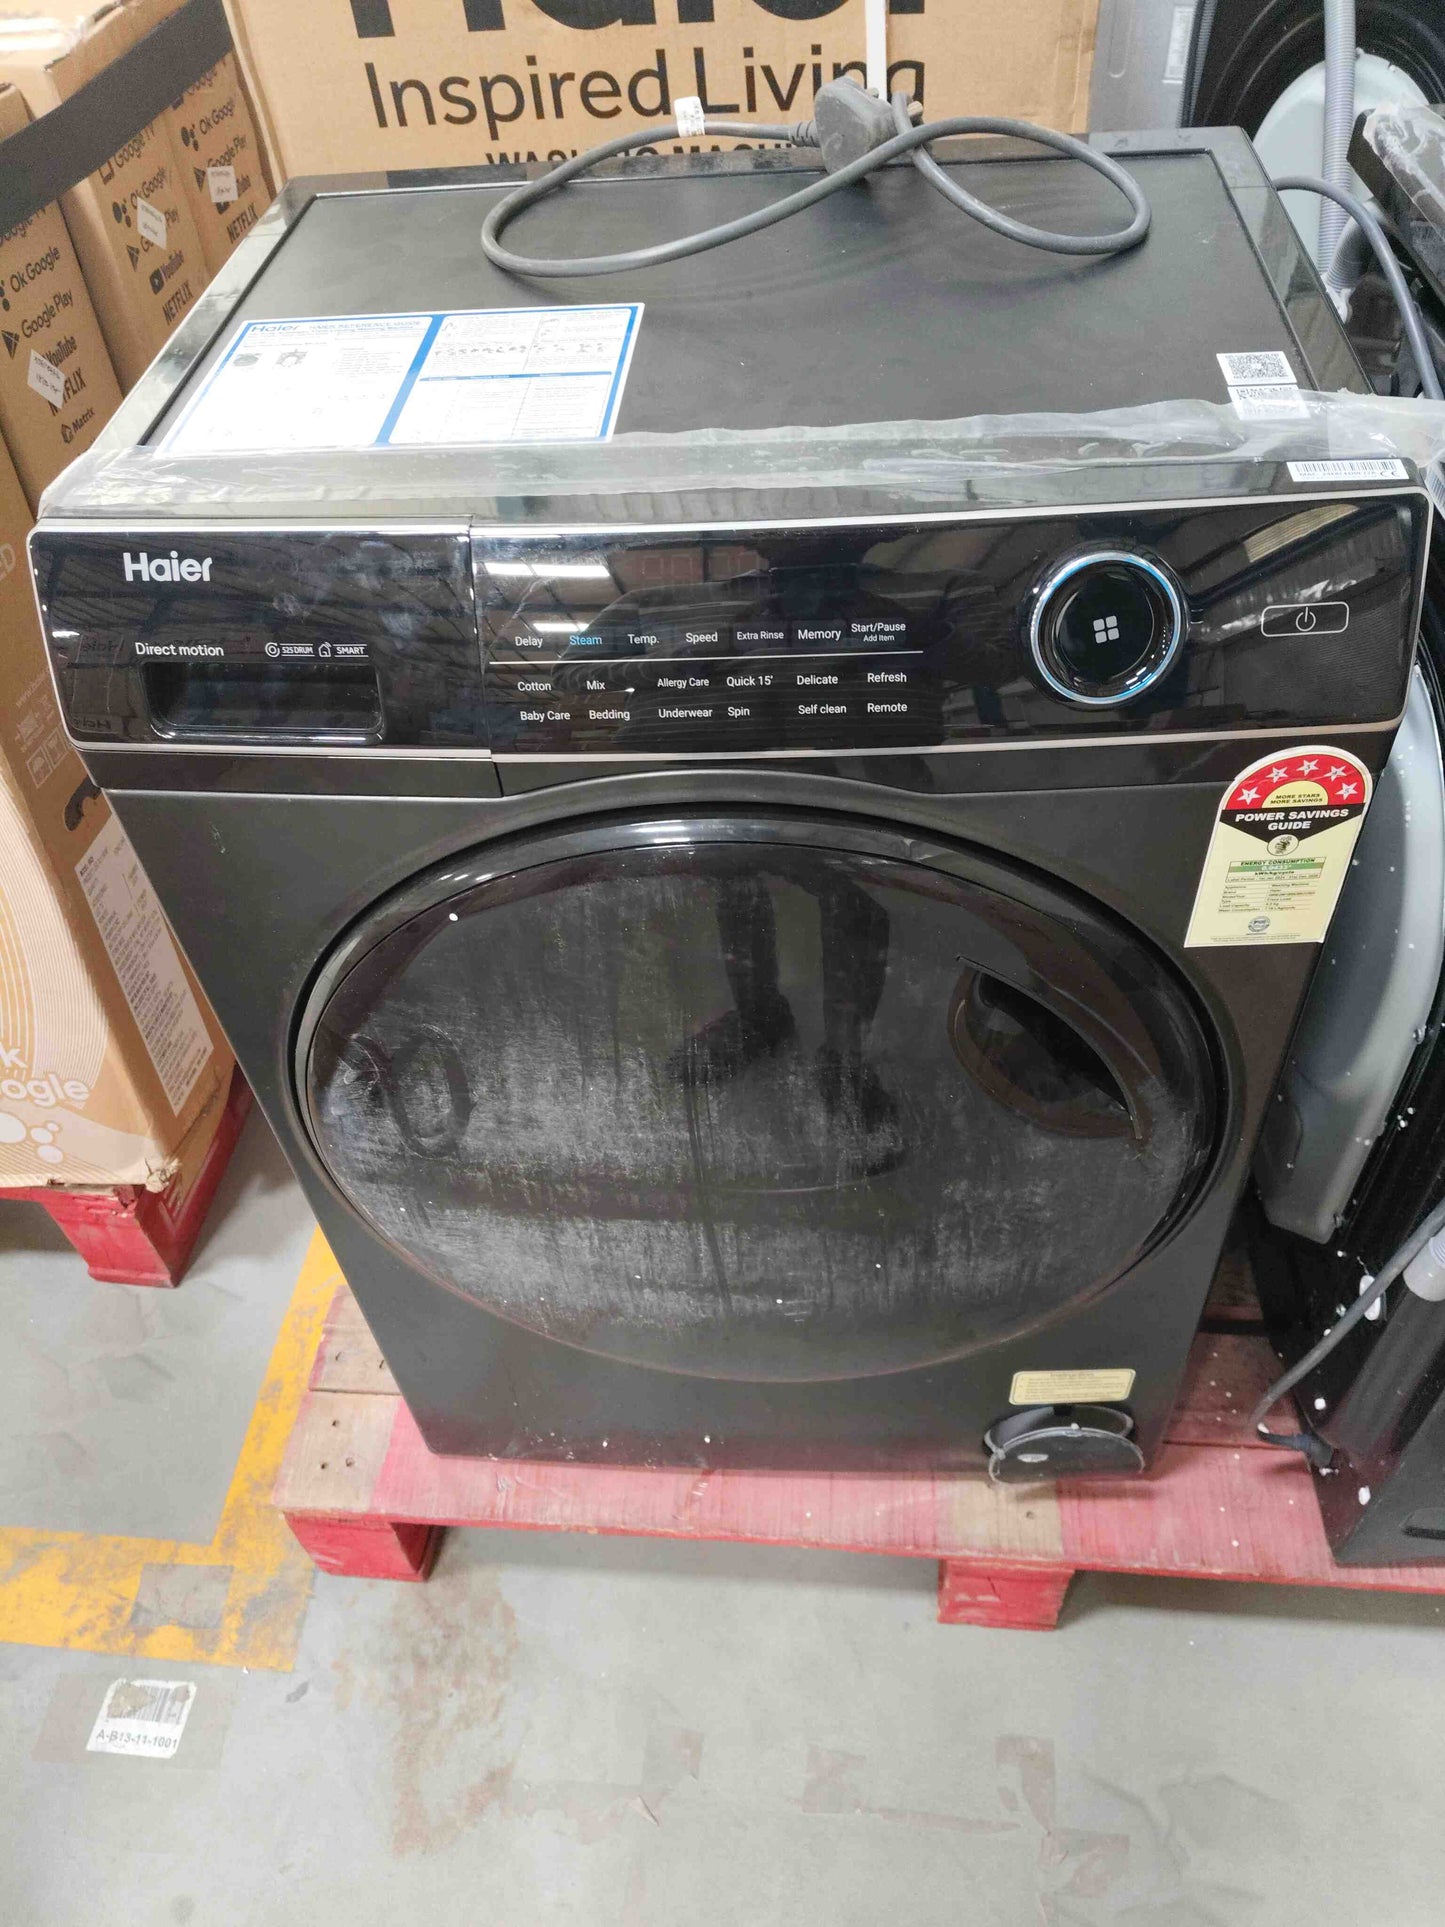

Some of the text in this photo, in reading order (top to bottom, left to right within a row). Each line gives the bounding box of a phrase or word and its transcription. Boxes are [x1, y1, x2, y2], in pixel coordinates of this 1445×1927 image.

[365, 48, 671, 140] Inspired
[226, 202, 258, 244] NETFLIX
[9, 245, 61, 293] Ok Google
[162, 281, 194, 326] NETFLIX
[21, 288, 74, 339] Google Play
[251, 325, 299, 333] Haier
[72, 407, 96, 434] Matrix
[123, 550, 213, 582] Haier
[851, 622, 906, 633] Start/Pause
[515, 635, 543, 648] Delay
[569, 635, 602, 646] Steam
[627, 633, 660, 646] Temp.
[685, 631, 718, 645] Speed
[736, 630, 784, 641] Extra Rinse
[798, 628, 842, 643] Memory
[863, 632, 895, 642] Add Item
[135, 642, 177, 656] Direct
[179, 643, 224, 657] motion
[336, 646, 365, 654] SMART
[657, 677, 710, 689] Allergy Care
[726, 675, 755, 687] Quick
[796, 674, 838, 685] Delicate
[867, 671, 907, 683] Refresh
[517, 680, 551, 691] Cotton
[586, 680, 606, 691] Mix
[658, 707, 713, 718] Underwear
[728, 706, 750, 718] Spin
[798, 703, 847, 715] Self clean
[867, 702, 908, 713] Remote
[520, 710, 570, 723] Baby Care
[589, 709, 630, 722] Bedding
[1235, 808, 1349, 822] POWER SAVINGS
[1267, 821, 1312, 831] GUIDE
